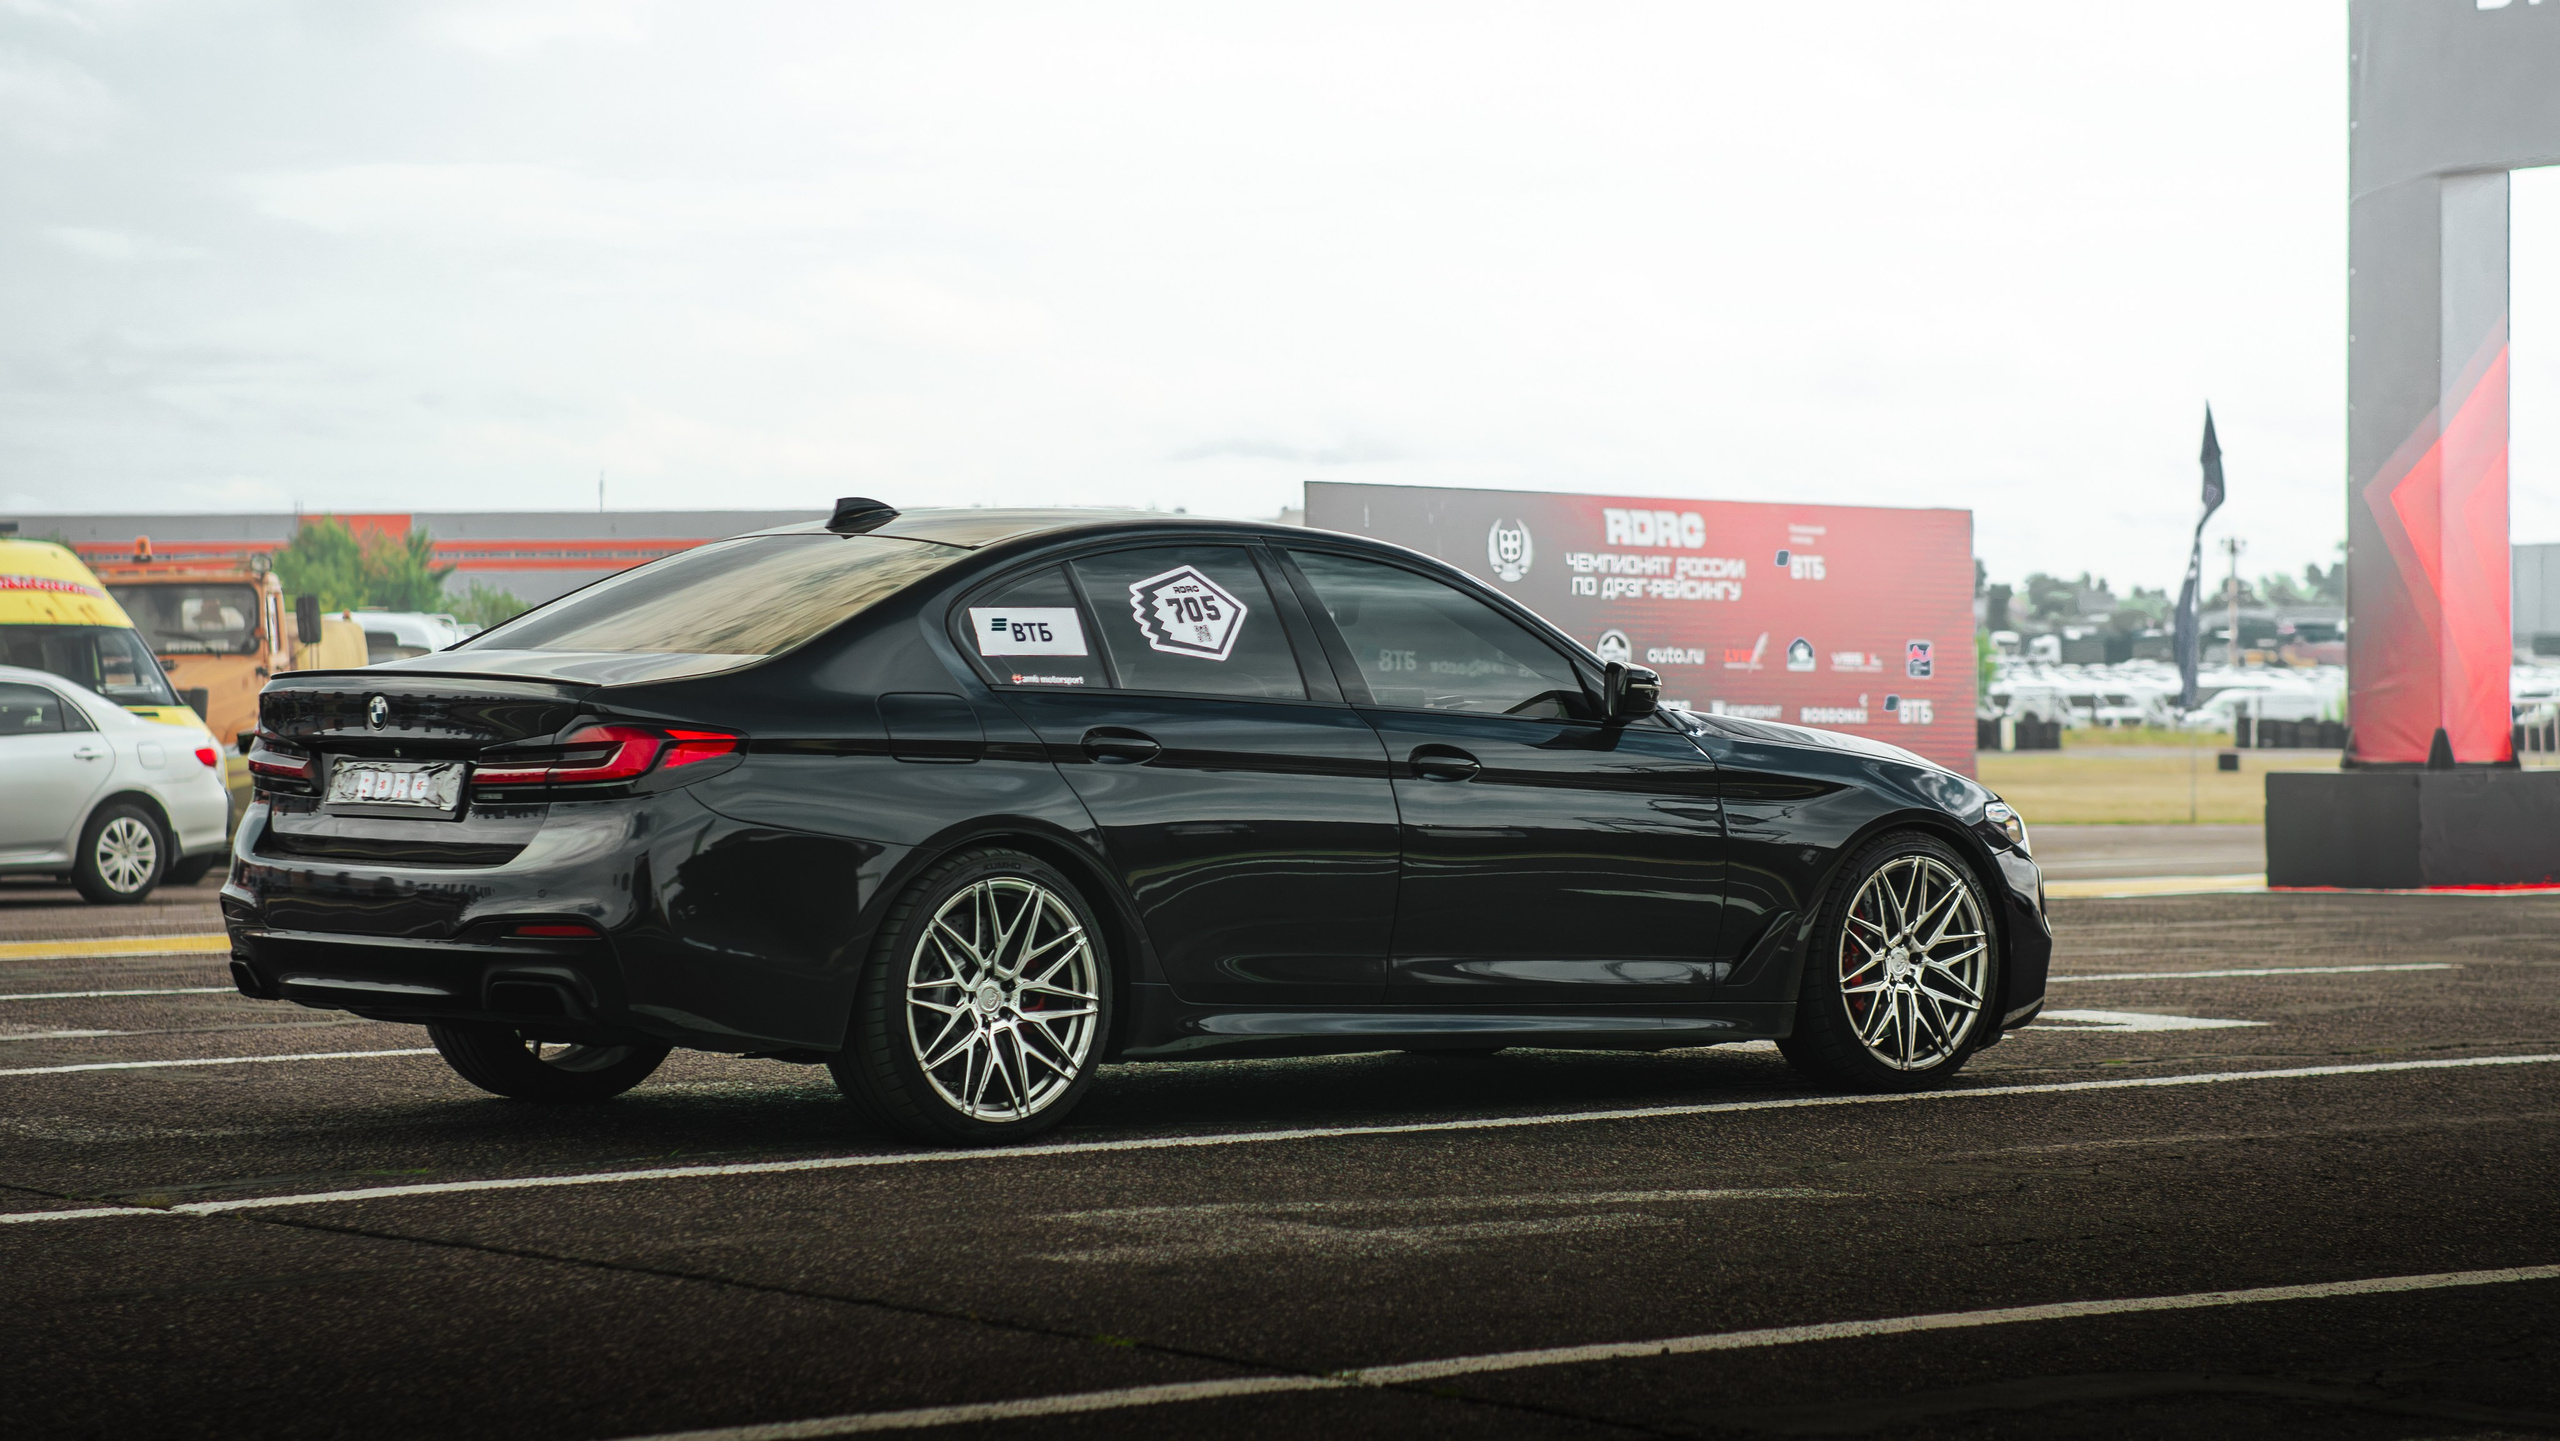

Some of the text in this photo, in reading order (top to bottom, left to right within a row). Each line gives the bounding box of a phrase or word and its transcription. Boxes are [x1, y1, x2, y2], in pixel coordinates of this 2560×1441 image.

[1603, 508, 1706, 549] RDRC
[1565, 552, 1746, 579] ЧЕМПИОНАТ РОССИИ
[1790, 554, 1826, 580] ВТБ
[1173, 585, 1200, 594] RDRC
[1571, 576, 1598, 596] ПО
[1165, 595, 1221, 624] 705
[1011, 623, 1053, 642] ВТБ
[1647, 647, 1705, 665] auto.ru
[1022, 675, 1084, 685] amb motorsport
[1898, 699, 1933, 724] ВТБ
